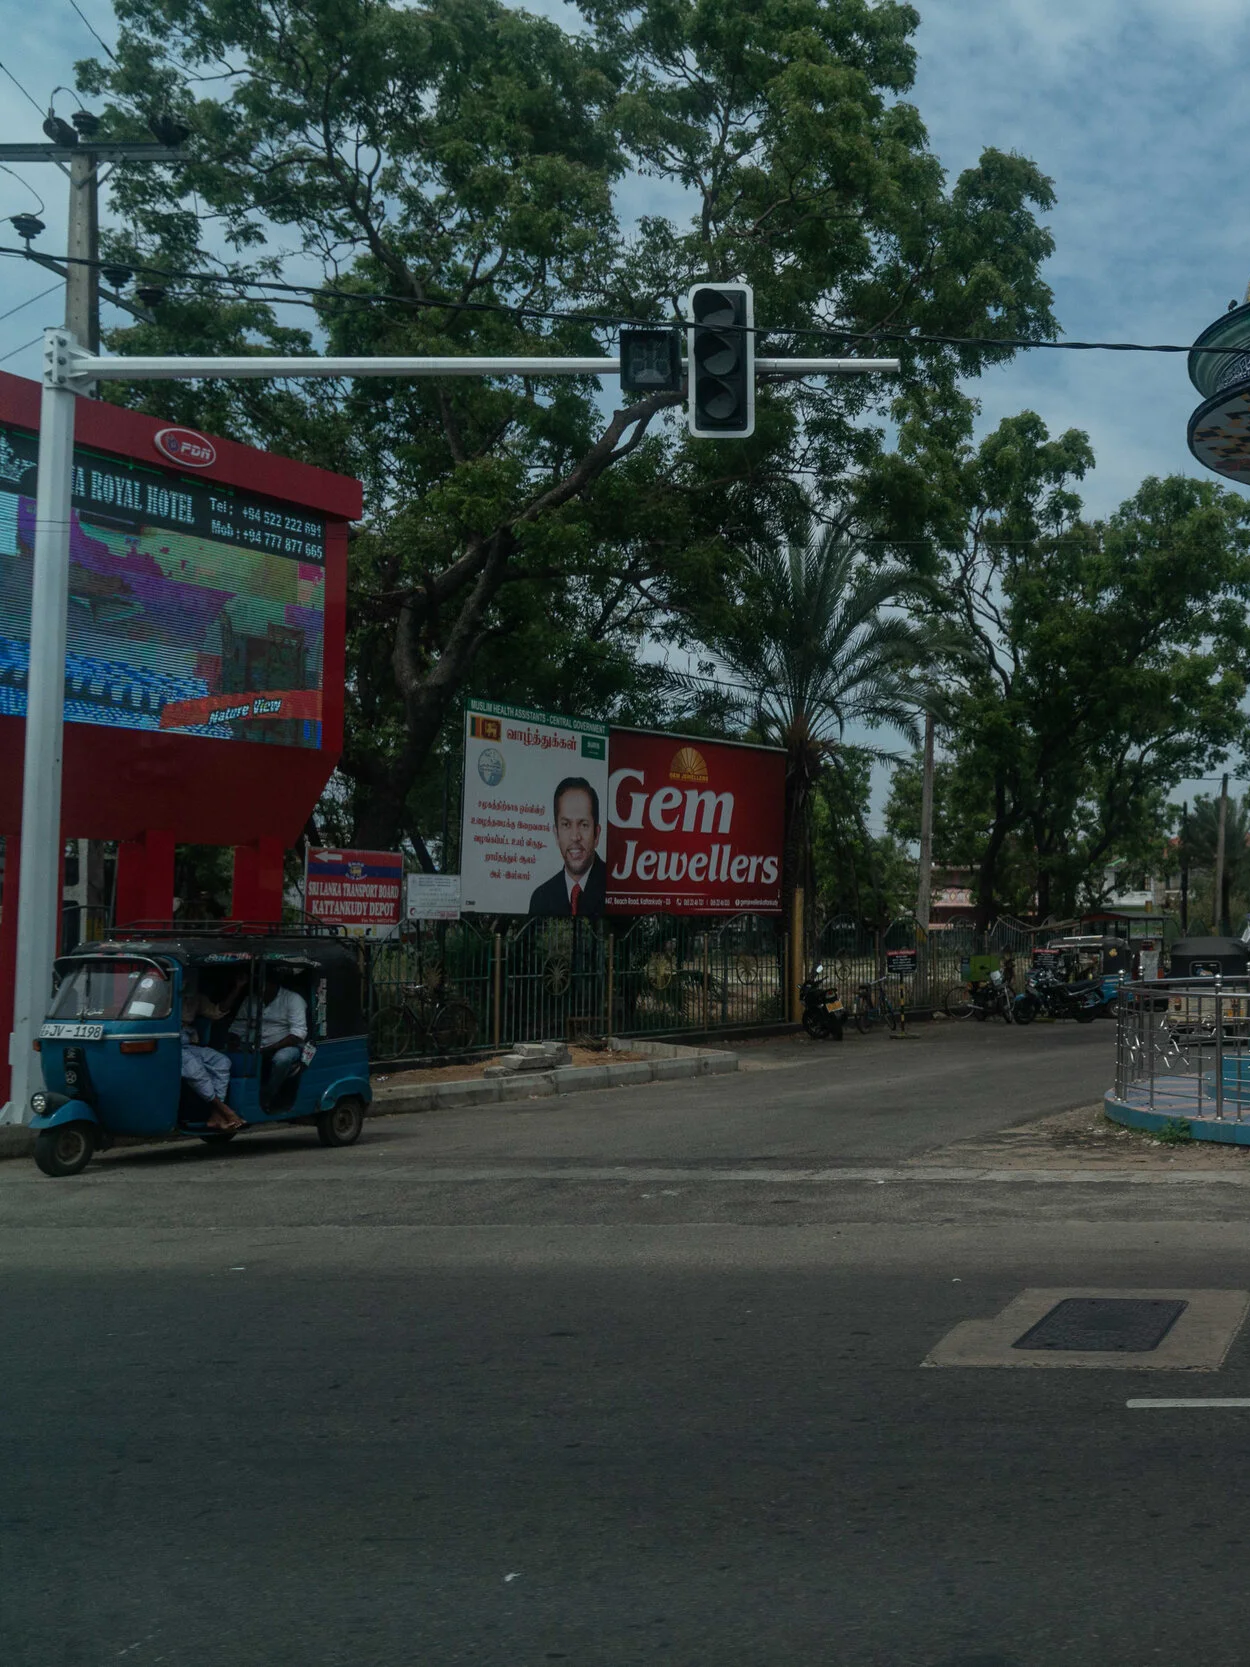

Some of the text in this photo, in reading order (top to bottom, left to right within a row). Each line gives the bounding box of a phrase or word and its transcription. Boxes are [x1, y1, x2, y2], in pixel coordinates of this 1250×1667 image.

[91, 470, 142, 511] ROYAL
[146, 484, 194, 524] HOTEL
[264, 511, 282, 527] 522
[284, 517, 303, 533] 222
[264, 532, 282, 549] 777
[285, 538, 303, 554] 877
[209, 698, 282, 725] Nature View
[471, 700, 492, 712] MUSLIM
[493, 702, 514, 715] HEALTH
[515, 705, 546, 723] ASSISTANTS
[549, 715, 572, 728] CENTRAL
[573, 719, 605, 734] GOVERNMENT
[506, 727, 577, 750] வாழ்த்துக்கள்
[608, 768, 735, 835] Gem
[611, 840, 779, 885] Jewellers
[308, 881, 399, 899] SRI LANKA TRANSPORT BOARD
[312, 900, 395, 916] KATTANKUDY DEPOT
